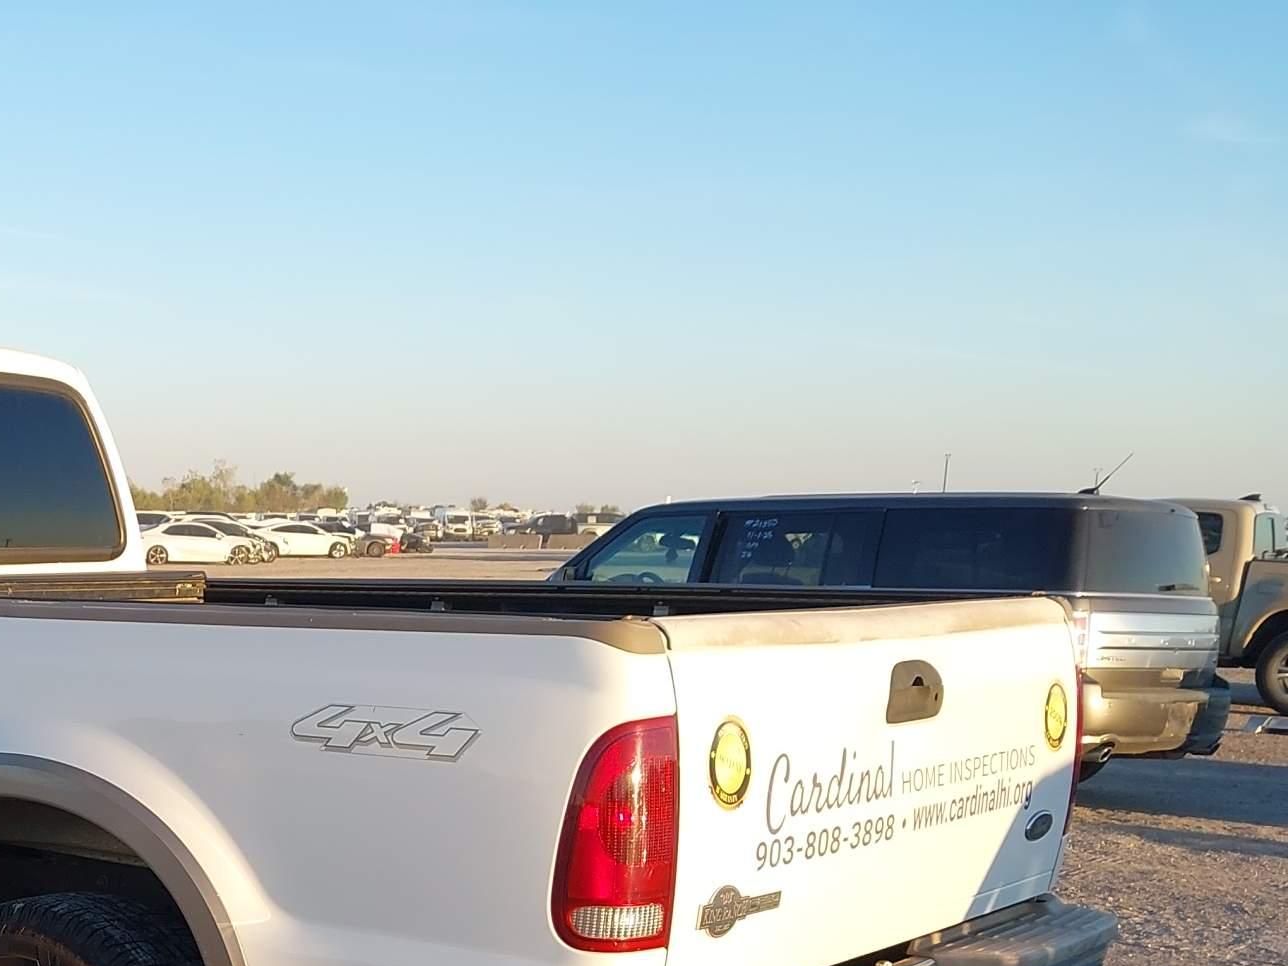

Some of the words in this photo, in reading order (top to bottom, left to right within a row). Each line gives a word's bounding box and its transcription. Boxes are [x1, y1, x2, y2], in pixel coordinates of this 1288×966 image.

[290, 703, 482, 762] 4x4
[755, 813, 896, 872] 903-808-3898
[912, 779, 1034, 832] www.cardinalhi.org
[765, 739, 896, 836] Cardinal
[902, 765, 945, 795] HOME
[949, 743, 1037, 784] INSPECTIONS
